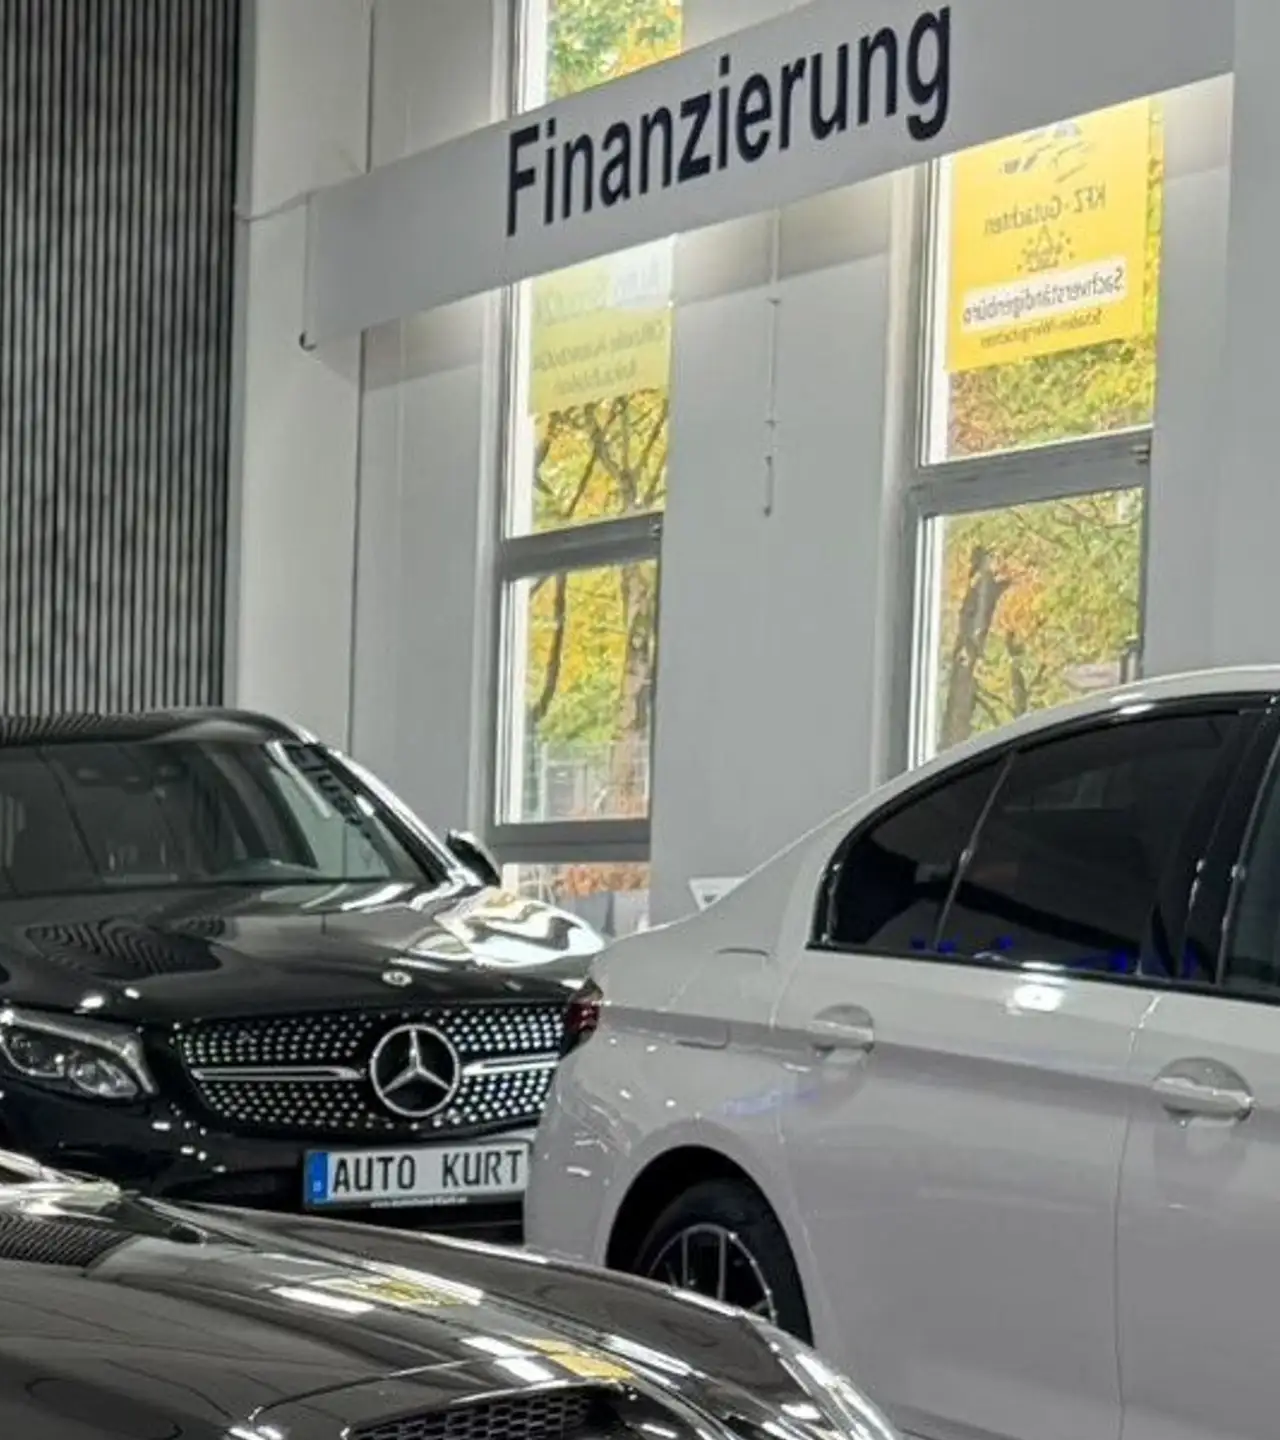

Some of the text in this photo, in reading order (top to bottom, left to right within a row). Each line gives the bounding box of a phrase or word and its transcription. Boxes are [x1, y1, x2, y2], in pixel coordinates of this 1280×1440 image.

[504, 6, 953, 237] Finanzierung
[333, 1154, 417, 1194] AUTO
[442, 1150, 524, 1188] KURT
